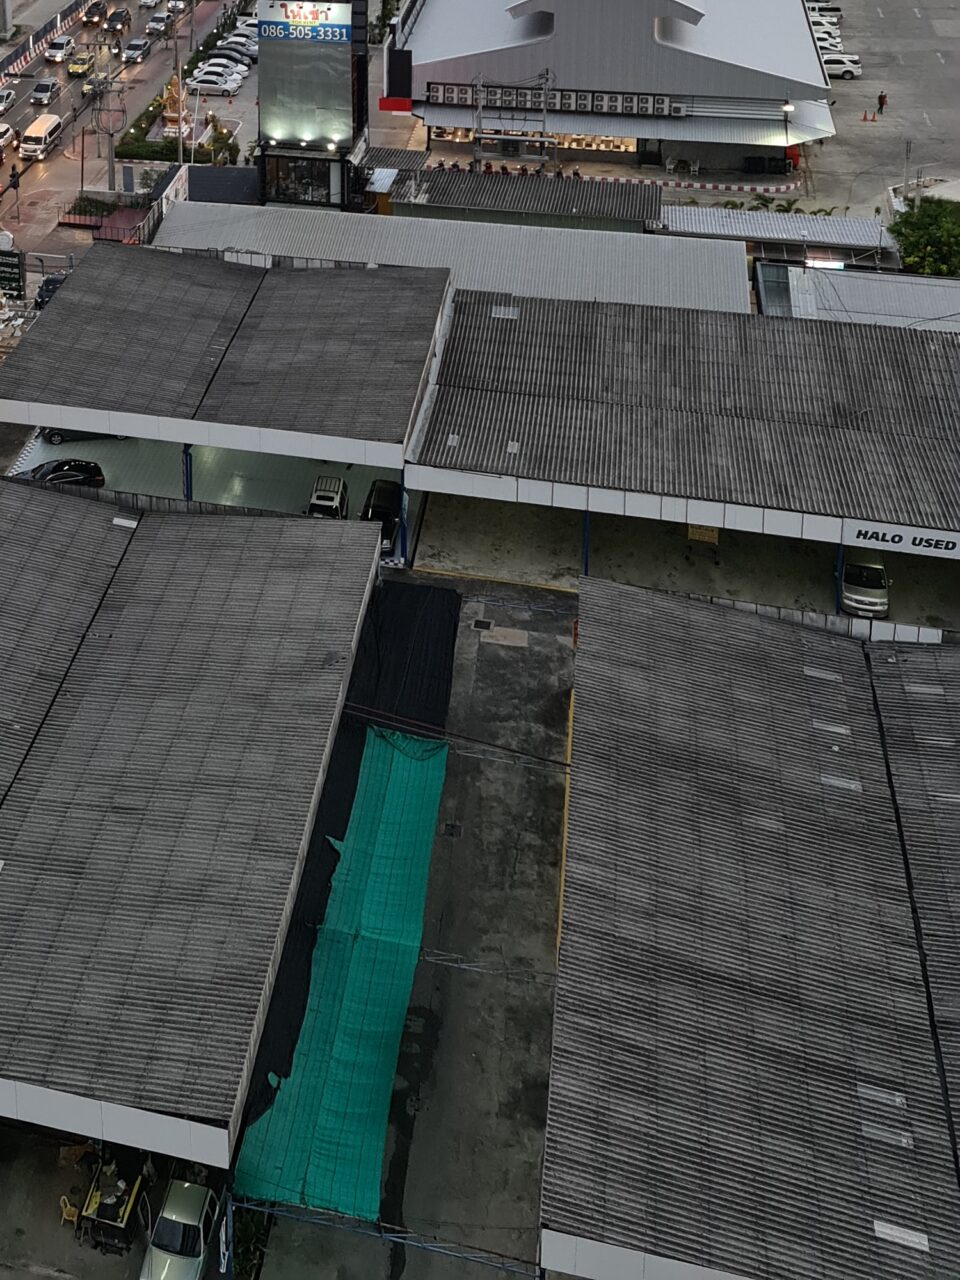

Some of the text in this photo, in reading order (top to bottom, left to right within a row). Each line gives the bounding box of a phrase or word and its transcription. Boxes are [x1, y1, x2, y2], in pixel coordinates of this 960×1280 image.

[280, 2, 329, 21] ให้เช่า
[261, 24, 348, 41] 086-505-3331
[855, 529, 957, 551] HALO USED
